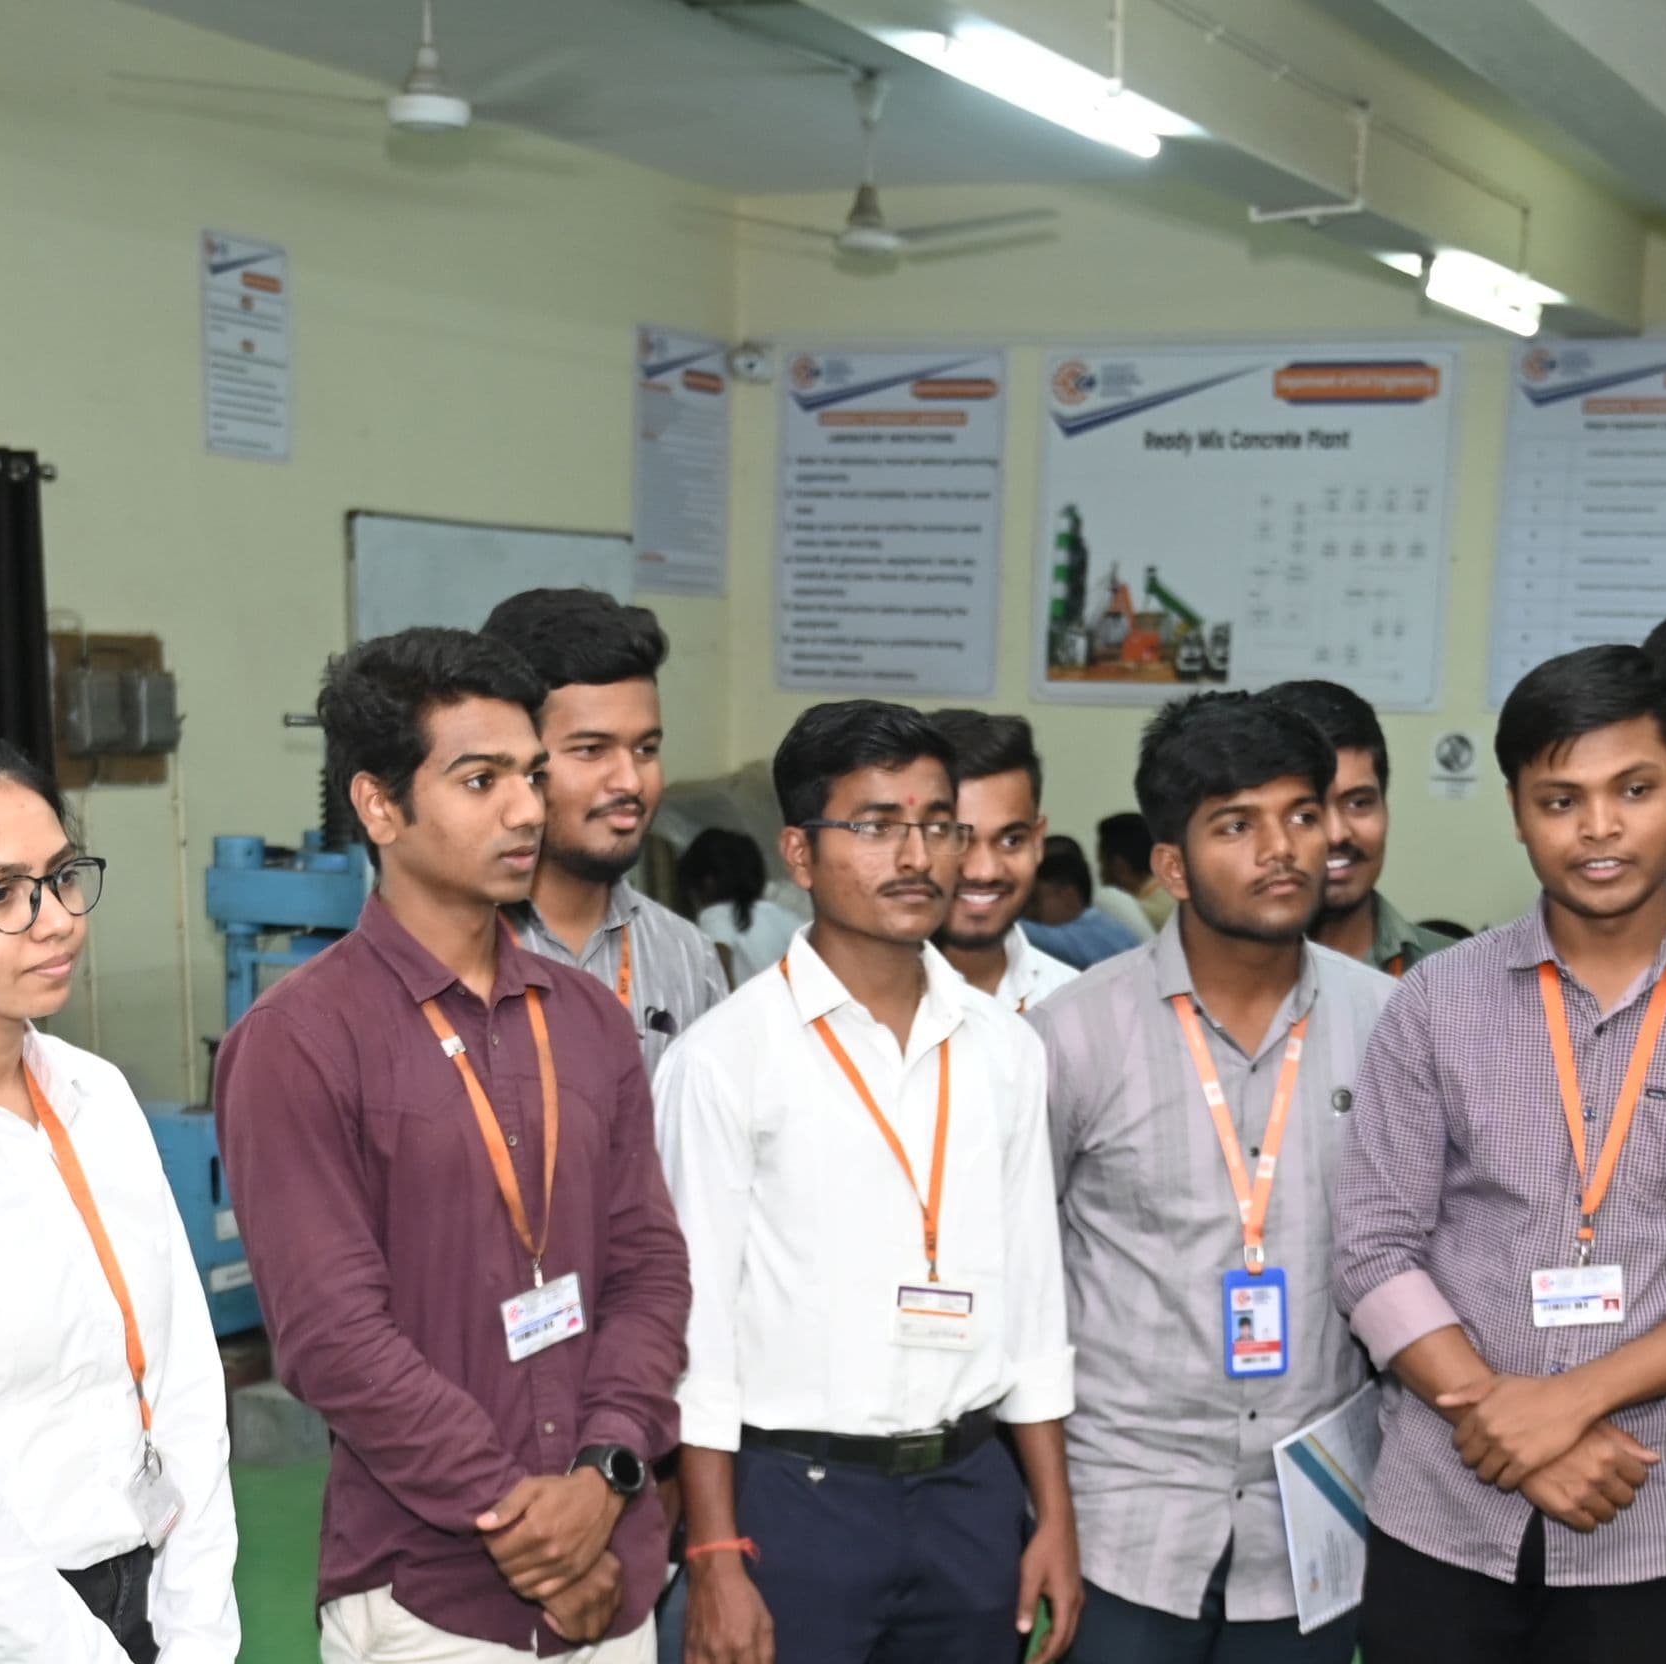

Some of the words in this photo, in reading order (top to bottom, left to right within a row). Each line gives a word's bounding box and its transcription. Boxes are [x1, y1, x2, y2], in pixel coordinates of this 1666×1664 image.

[1144, 429, 1194, 456] Ready
[1197, 430, 1224, 450] Mix
[1231, 429, 1302, 450] Concrete
[1307, 428, 1350, 450] Plant
